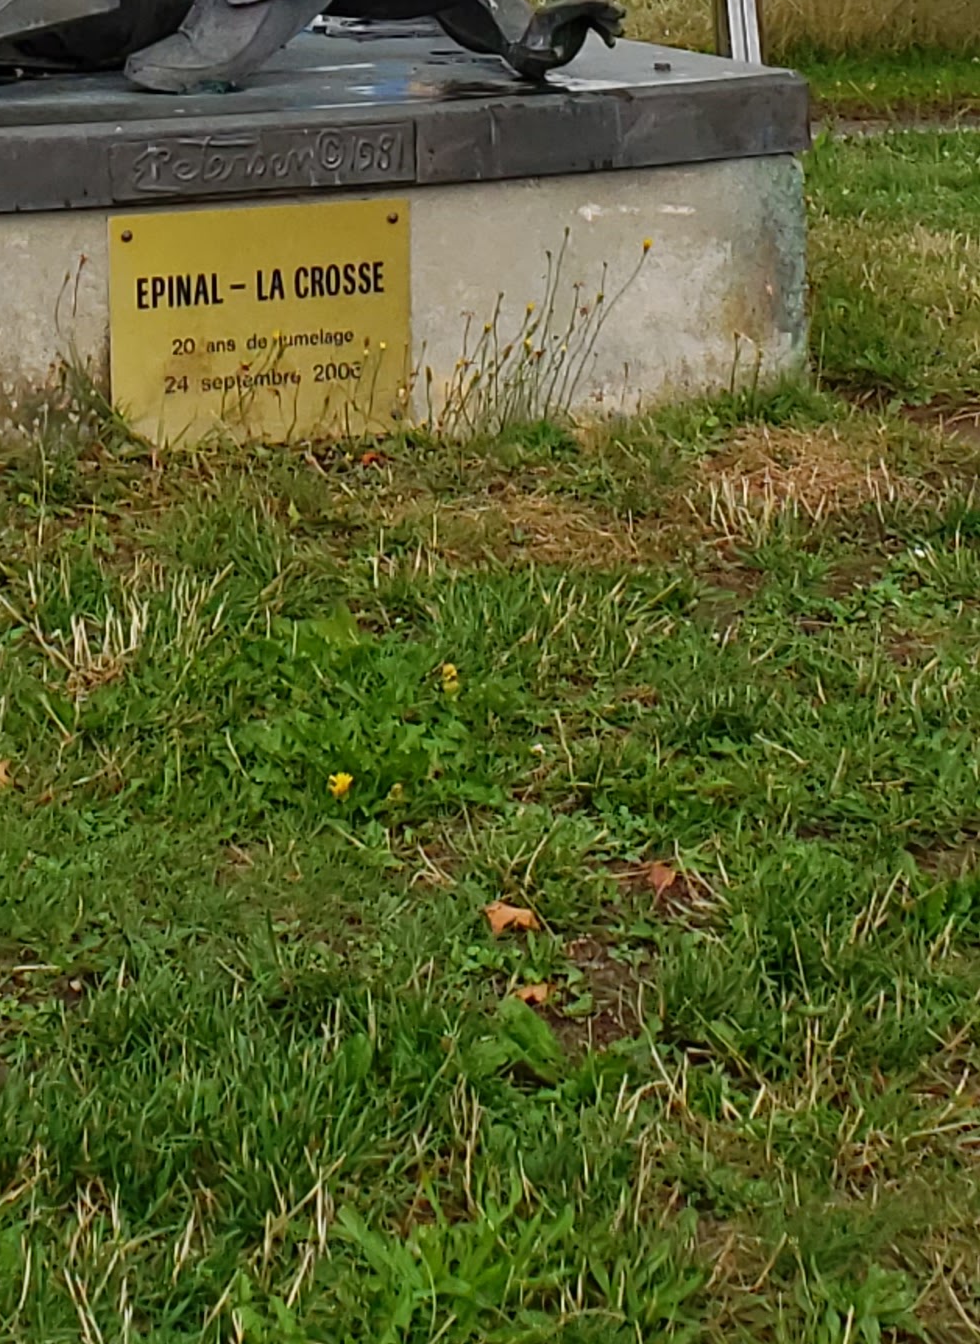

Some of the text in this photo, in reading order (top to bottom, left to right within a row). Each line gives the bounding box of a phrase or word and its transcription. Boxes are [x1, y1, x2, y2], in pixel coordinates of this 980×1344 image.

[136, 272, 223, 309] EPINAL
[256, 269, 285, 301] LA
[294, 261, 385, 299] CROSSE
[172, 338, 196, 356] 20
[207, 338, 236, 353] ans
[246, 334, 267, 350] de
[164, 376, 189, 394] 24
[202, 368, 301, 393] septembre
